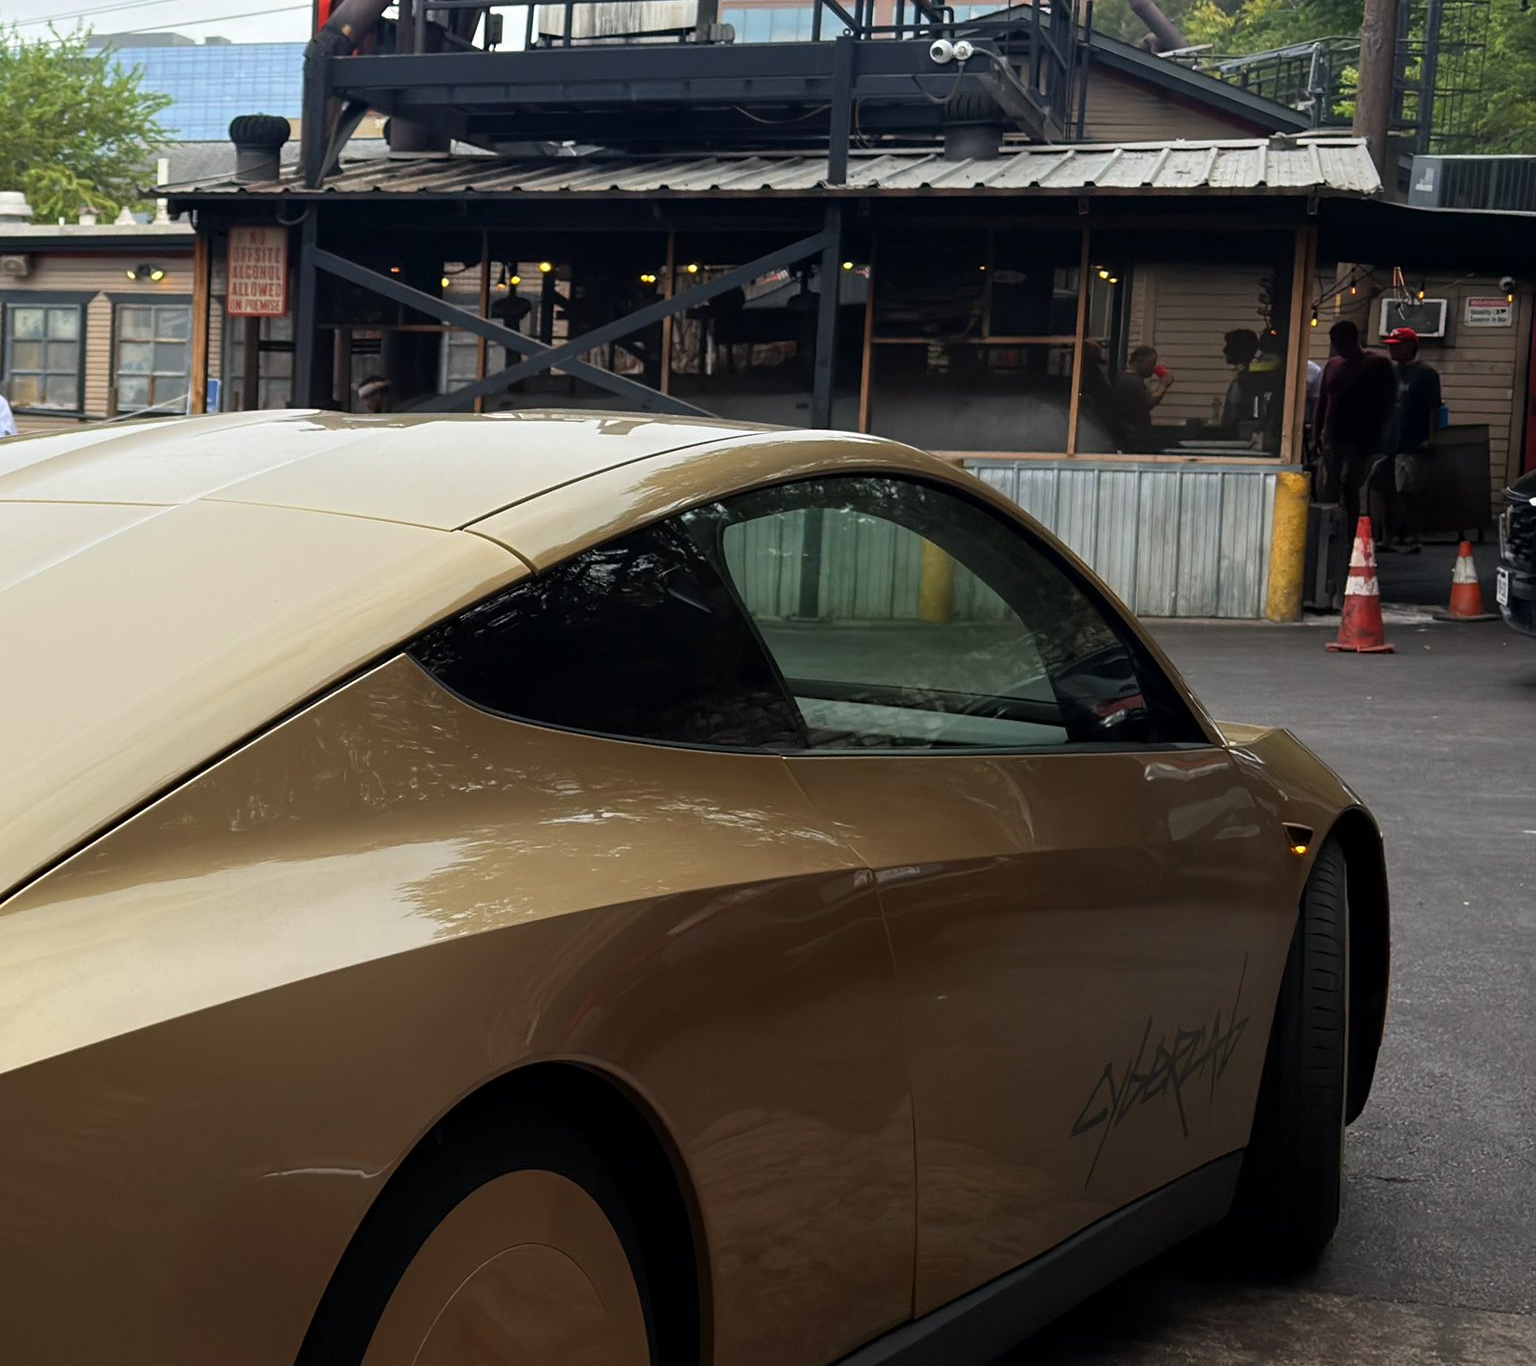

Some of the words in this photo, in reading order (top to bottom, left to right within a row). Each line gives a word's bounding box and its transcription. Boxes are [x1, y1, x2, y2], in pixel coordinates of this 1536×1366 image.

[249, 230, 265, 246] NO
[232, 247, 281, 263] OFFSITE
[232, 265, 281, 280] ALCOHOL
[231, 282, 282, 297] ALLOWED
[229, 298, 242, 311] ON
[244, 299, 281, 311] PREMISE
